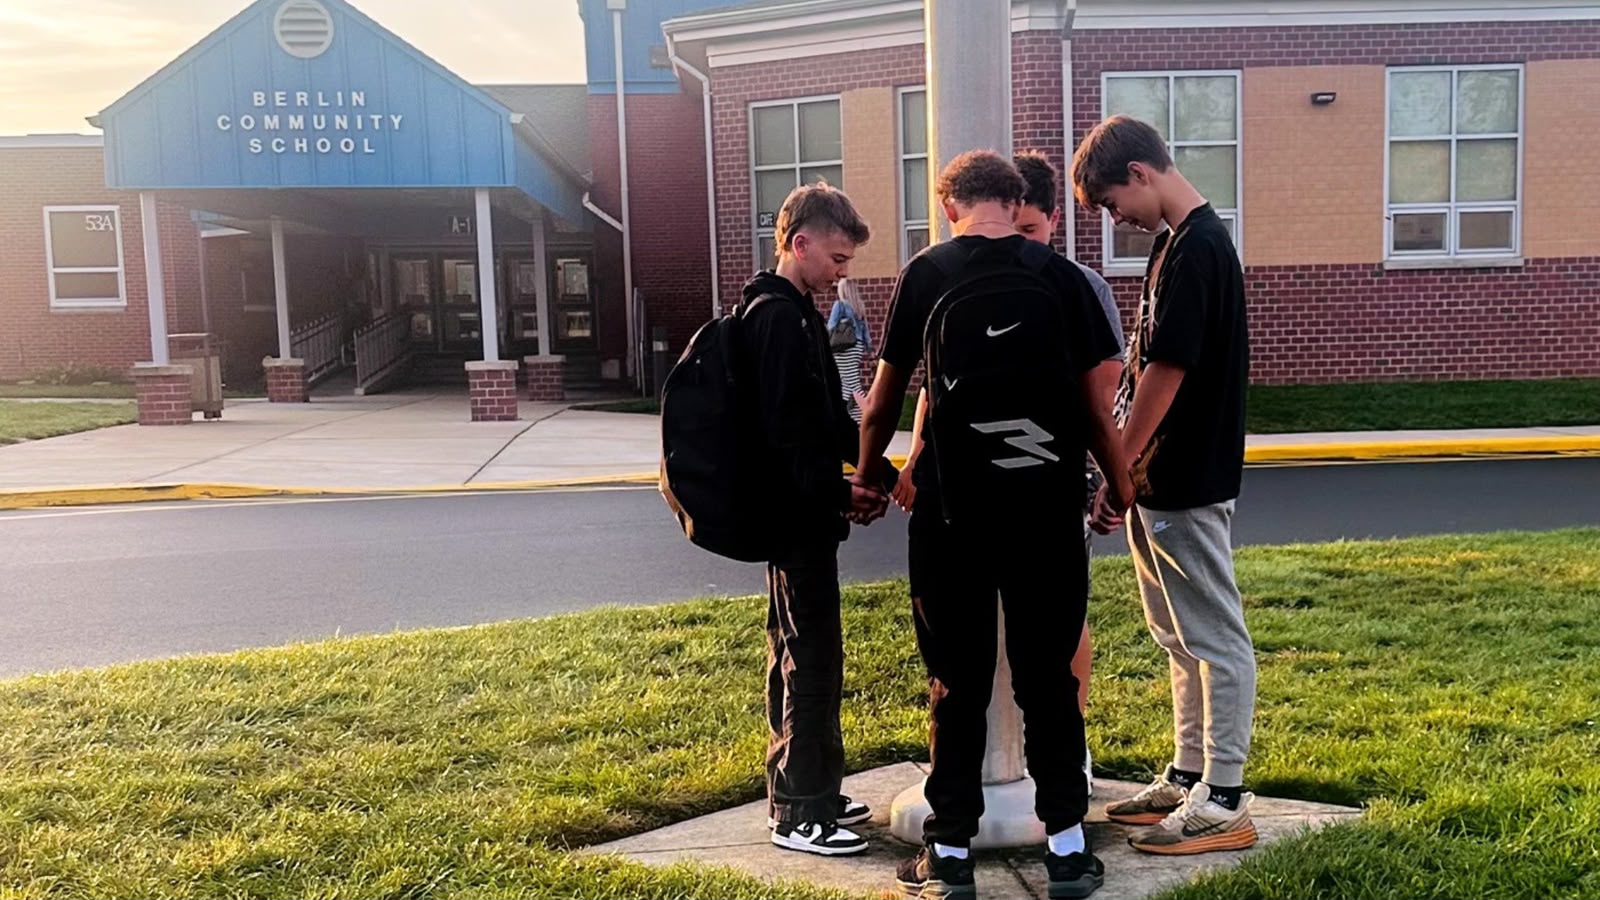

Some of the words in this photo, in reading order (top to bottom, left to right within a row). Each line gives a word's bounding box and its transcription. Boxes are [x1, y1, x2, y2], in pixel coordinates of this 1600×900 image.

[253, 91, 366, 107] BERLIN
[217, 115, 403, 130] COMMUNITY
[249, 138, 376, 153] SCHOOL
[85, 215, 114, 231] 53A
[452, 216, 471, 233] A-1
